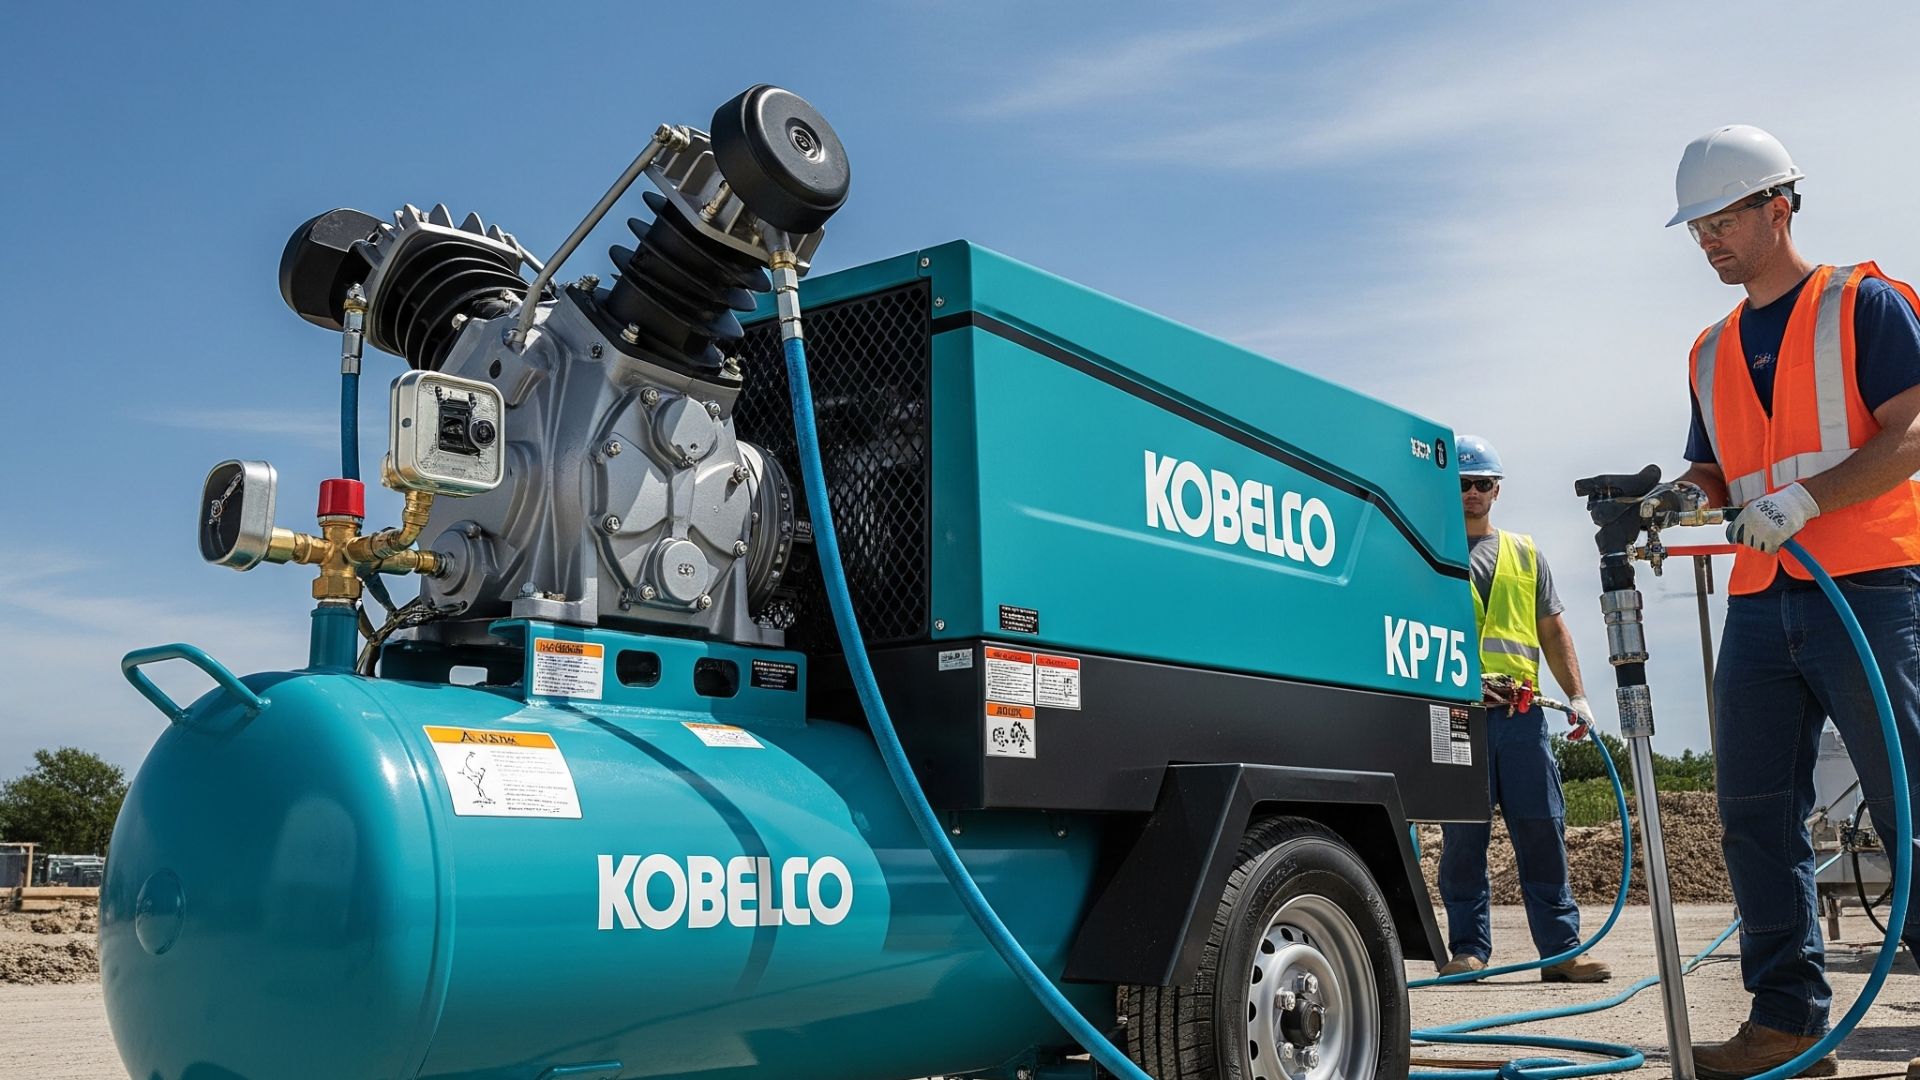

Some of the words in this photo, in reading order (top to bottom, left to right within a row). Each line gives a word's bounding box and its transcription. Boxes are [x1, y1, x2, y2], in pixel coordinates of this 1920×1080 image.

[1144, 450, 1336, 567] KOBELCO
[1384, 615, 1468, 687] KP75
[597, 853, 853, 930] KOBELCO
